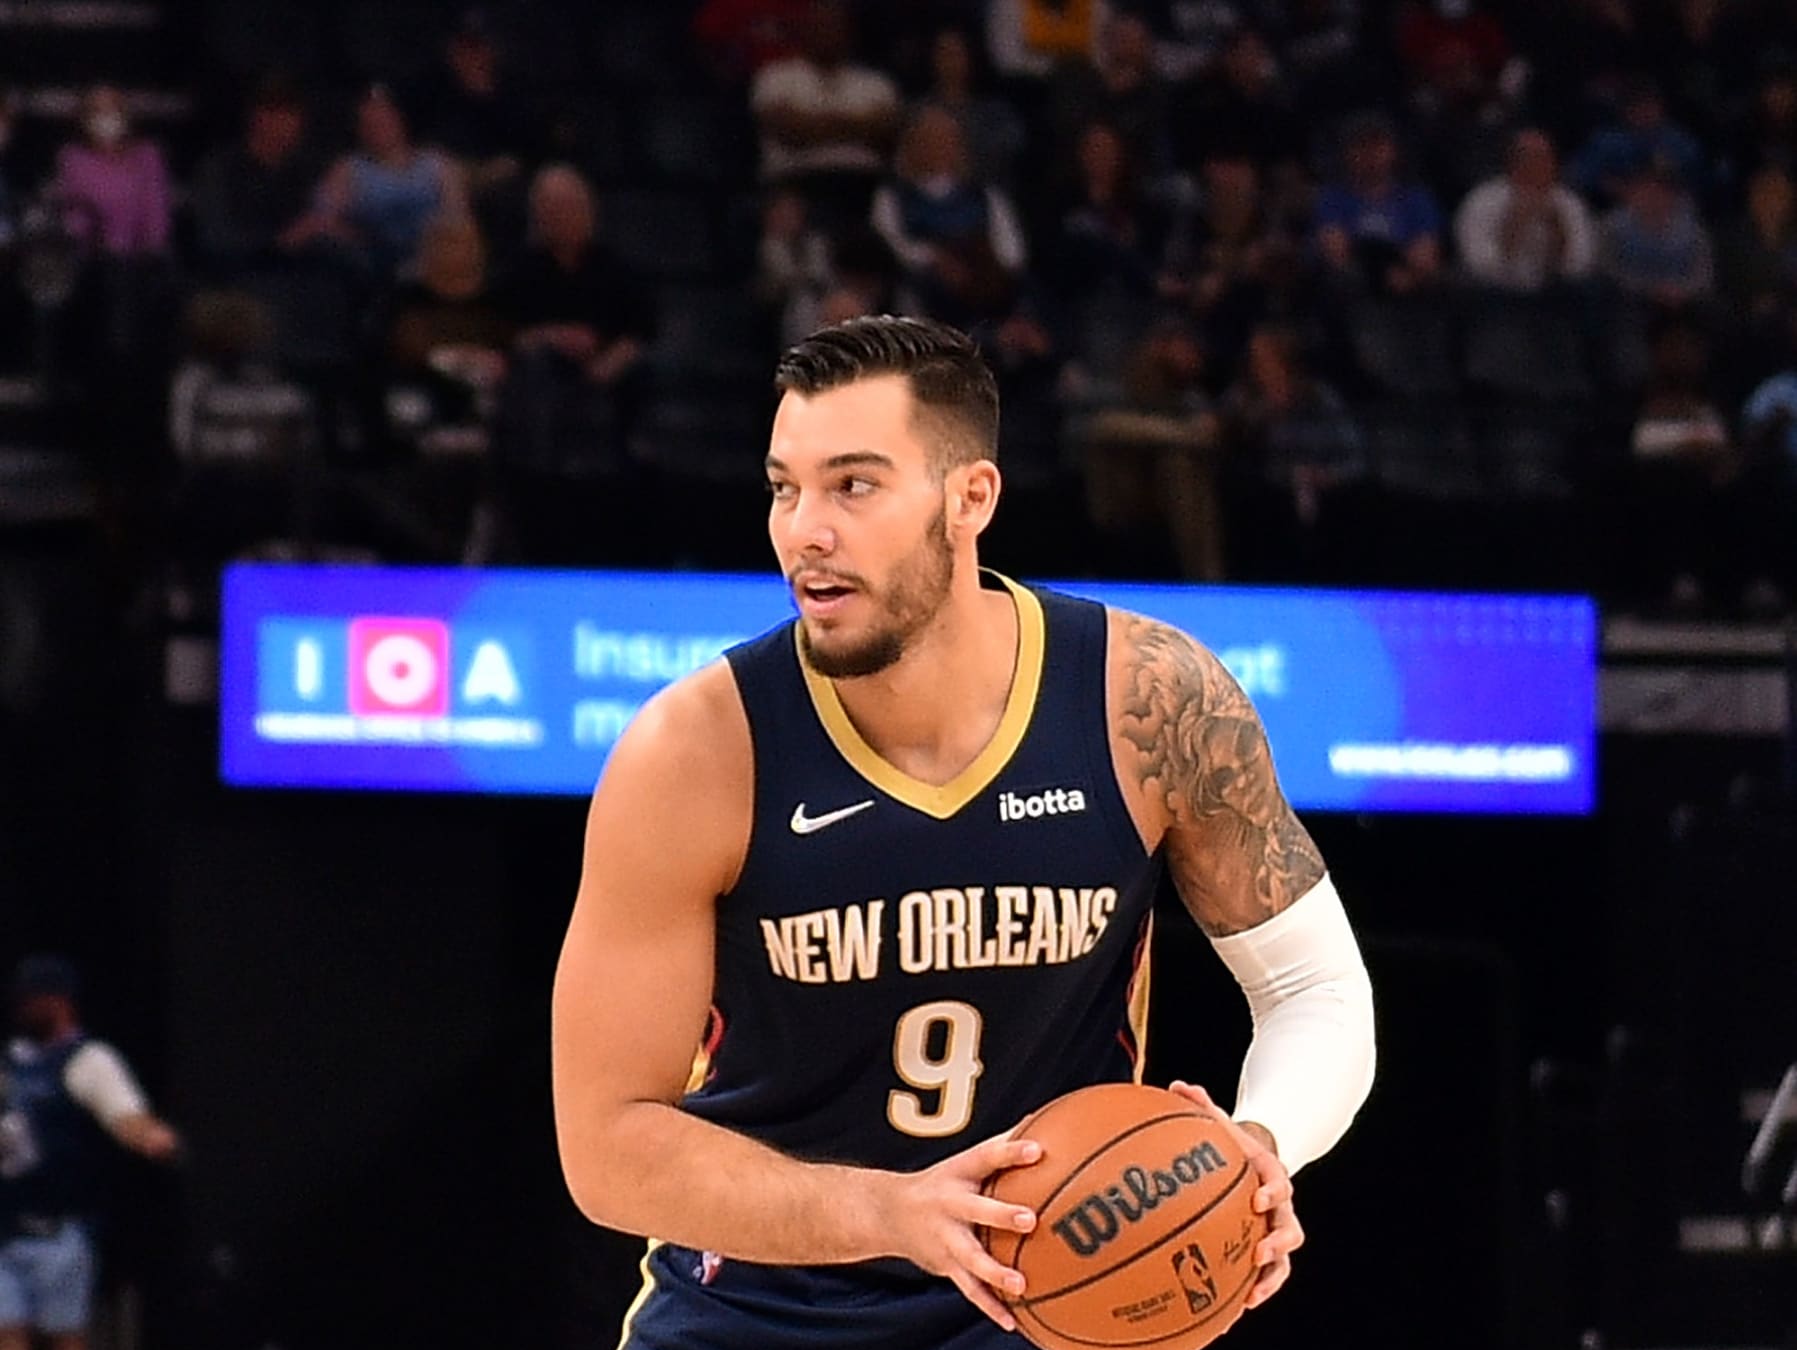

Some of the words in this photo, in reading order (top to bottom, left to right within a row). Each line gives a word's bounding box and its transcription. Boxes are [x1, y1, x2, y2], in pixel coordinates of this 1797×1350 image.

[999, 789, 1086, 822] ibotta
[760, 900, 885, 983] NEW
[898, 886, 1118, 973] ORLEANS
[887, 1001, 983, 1137] 9
[1052, 1141, 1226, 1256] Wilson
